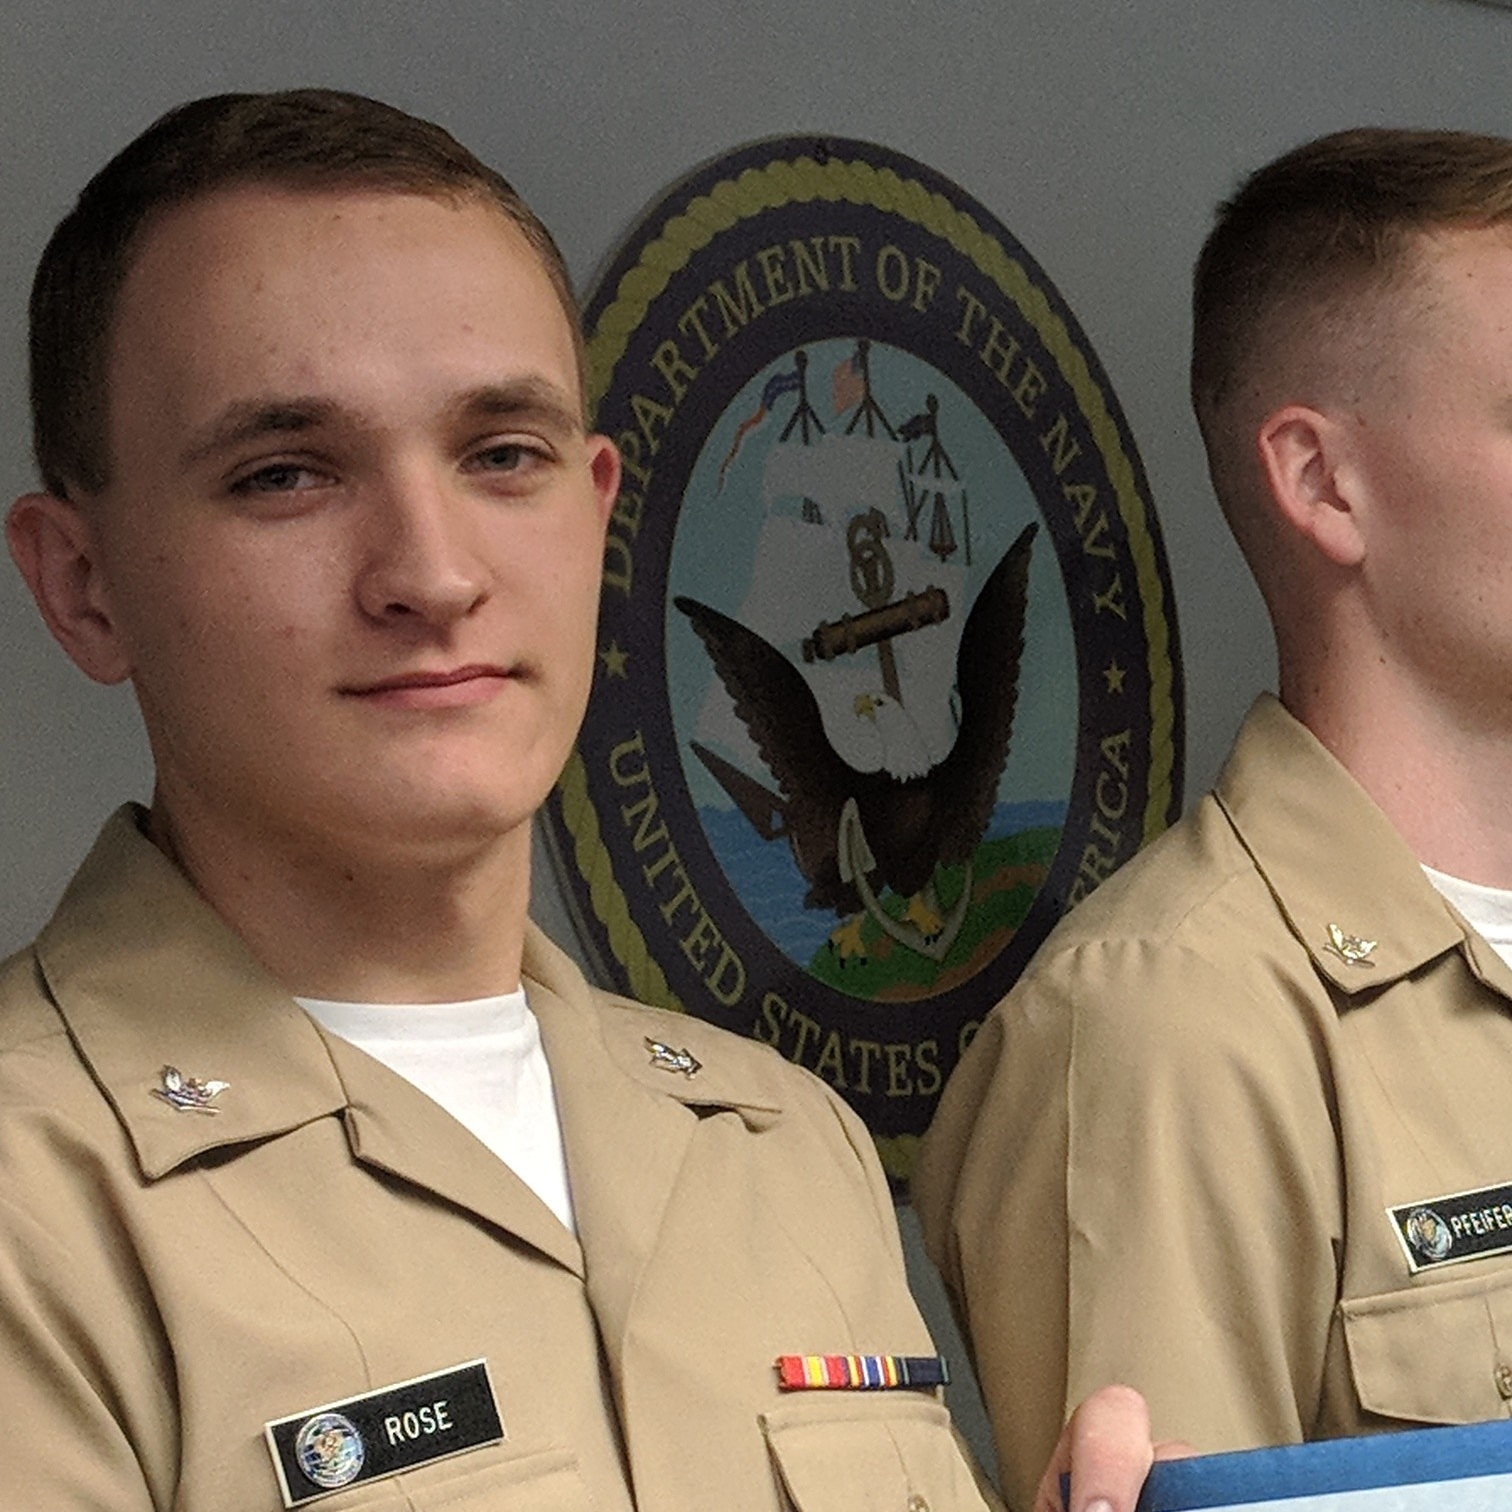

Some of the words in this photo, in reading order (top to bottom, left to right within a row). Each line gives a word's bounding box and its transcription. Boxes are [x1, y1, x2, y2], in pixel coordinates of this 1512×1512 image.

[603, 234, 861, 596] DEPARTMENT
[876, 243, 942, 314] OF
[954, 286, 1051, 420] THE
[1040, 413, 1127, 622] NAVY
[608, 730, 746, 1007] UNITED
[754, 991, 942, 1097] STATES
[384, 1400, 453, 1446] ROSE
